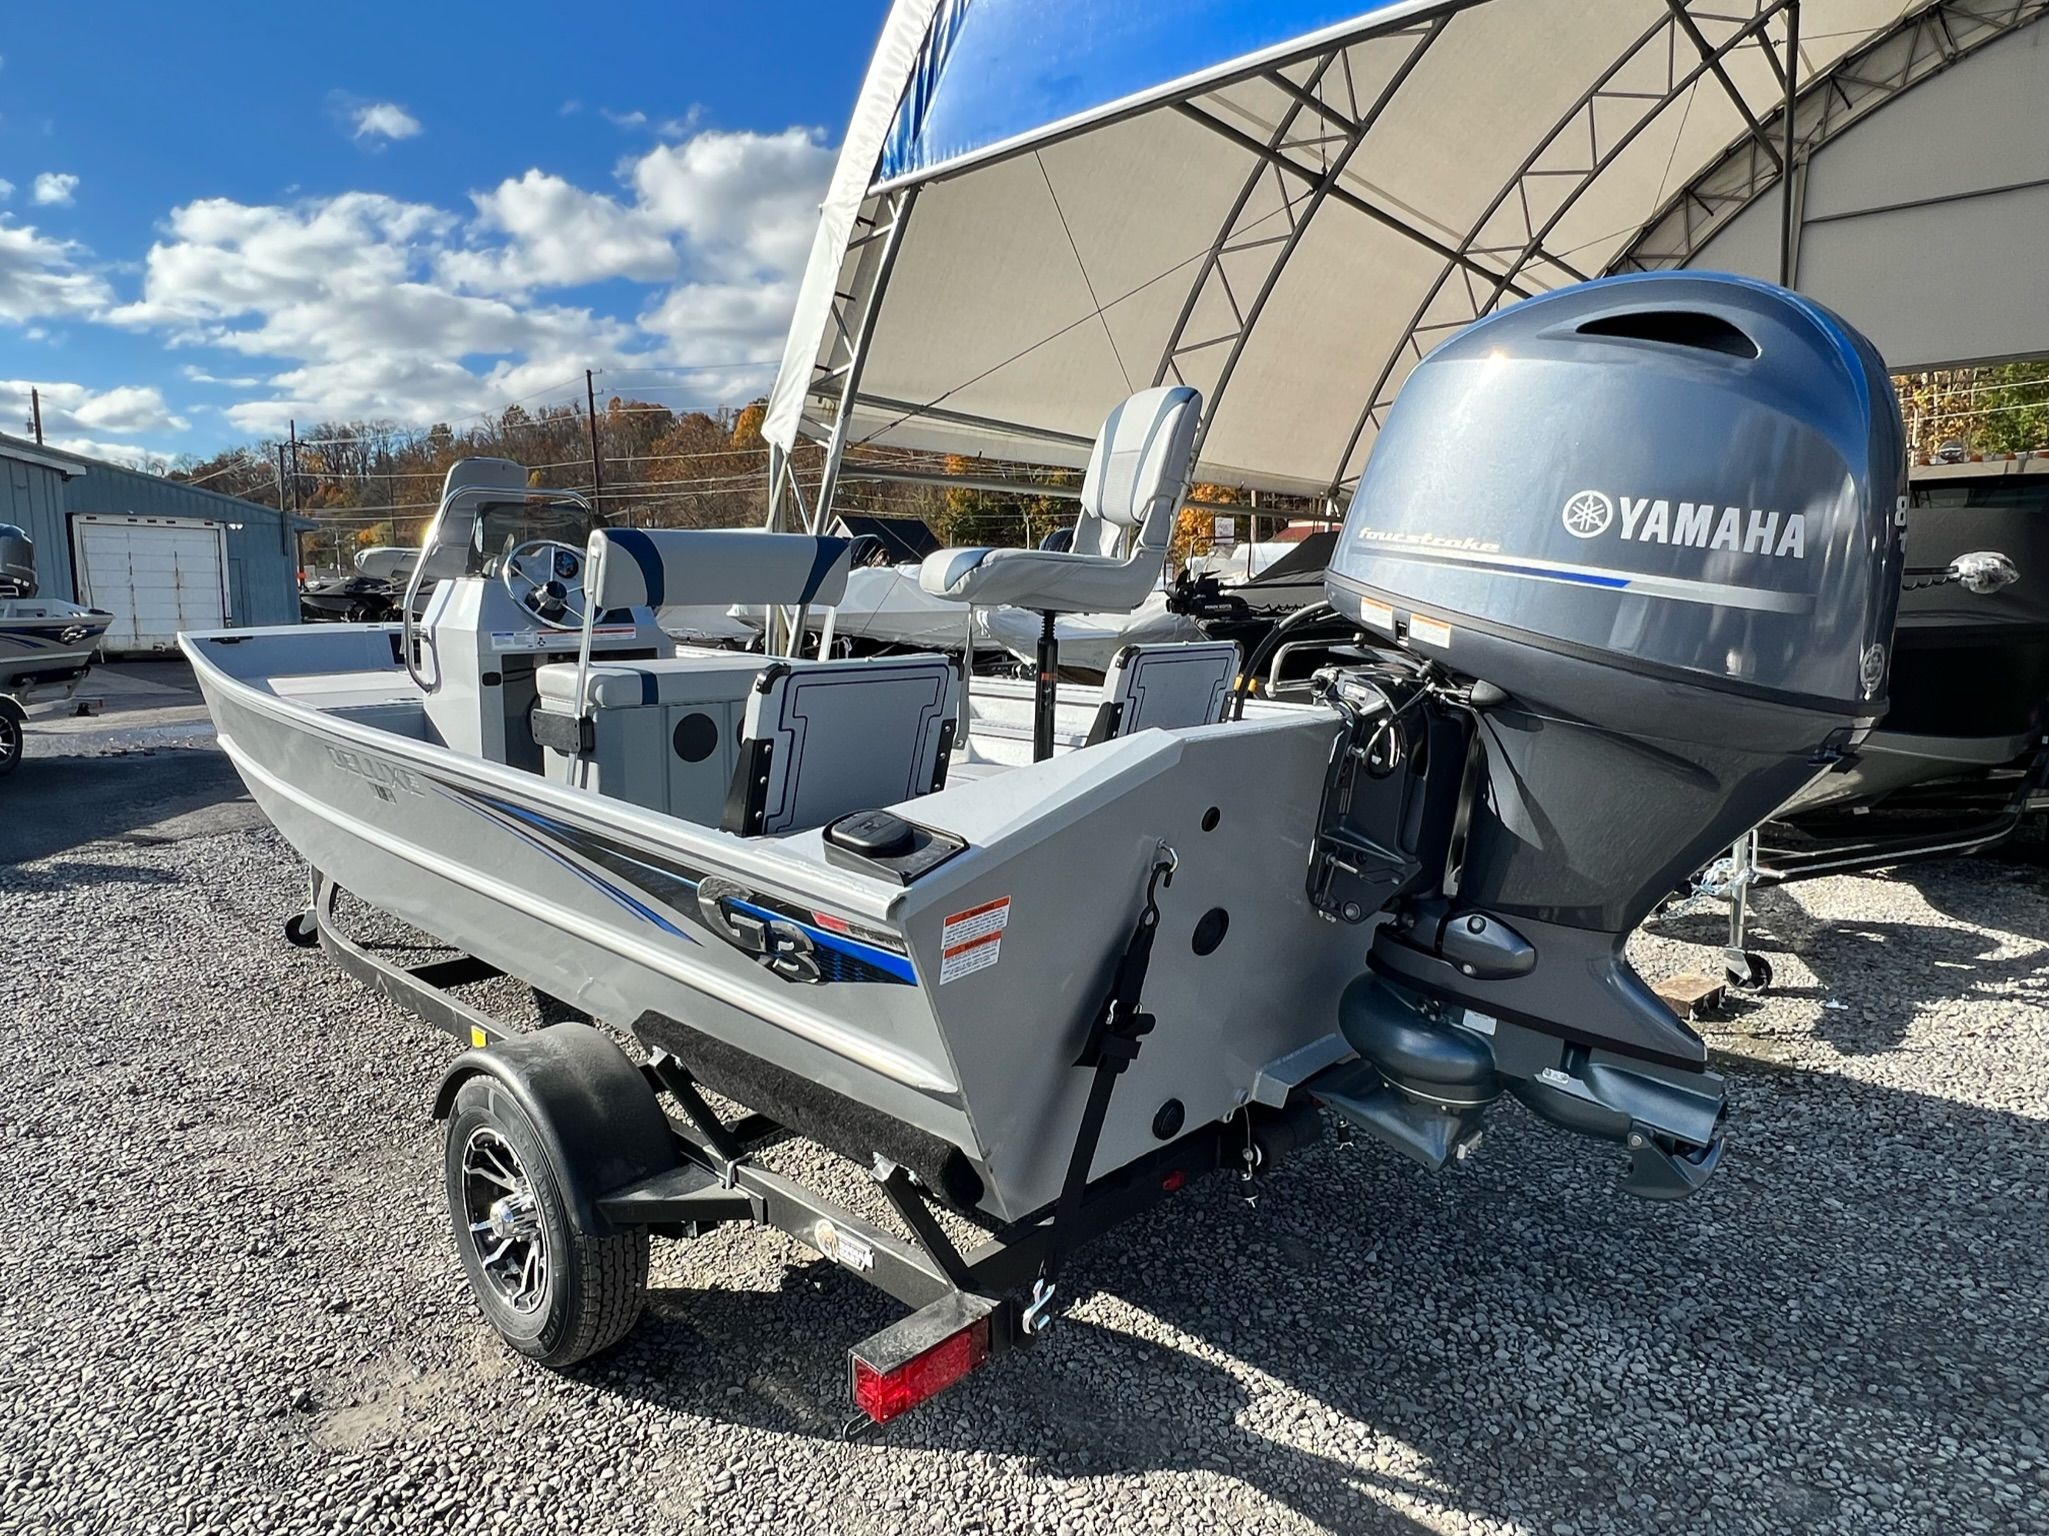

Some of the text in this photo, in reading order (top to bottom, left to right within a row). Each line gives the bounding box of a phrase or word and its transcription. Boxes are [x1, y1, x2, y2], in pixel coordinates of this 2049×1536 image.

[1359, 527, 1501, 553] fourstroke
[1619, 497, 1806, 559] YAMAHA
[697, 875, 821, 985] G3
